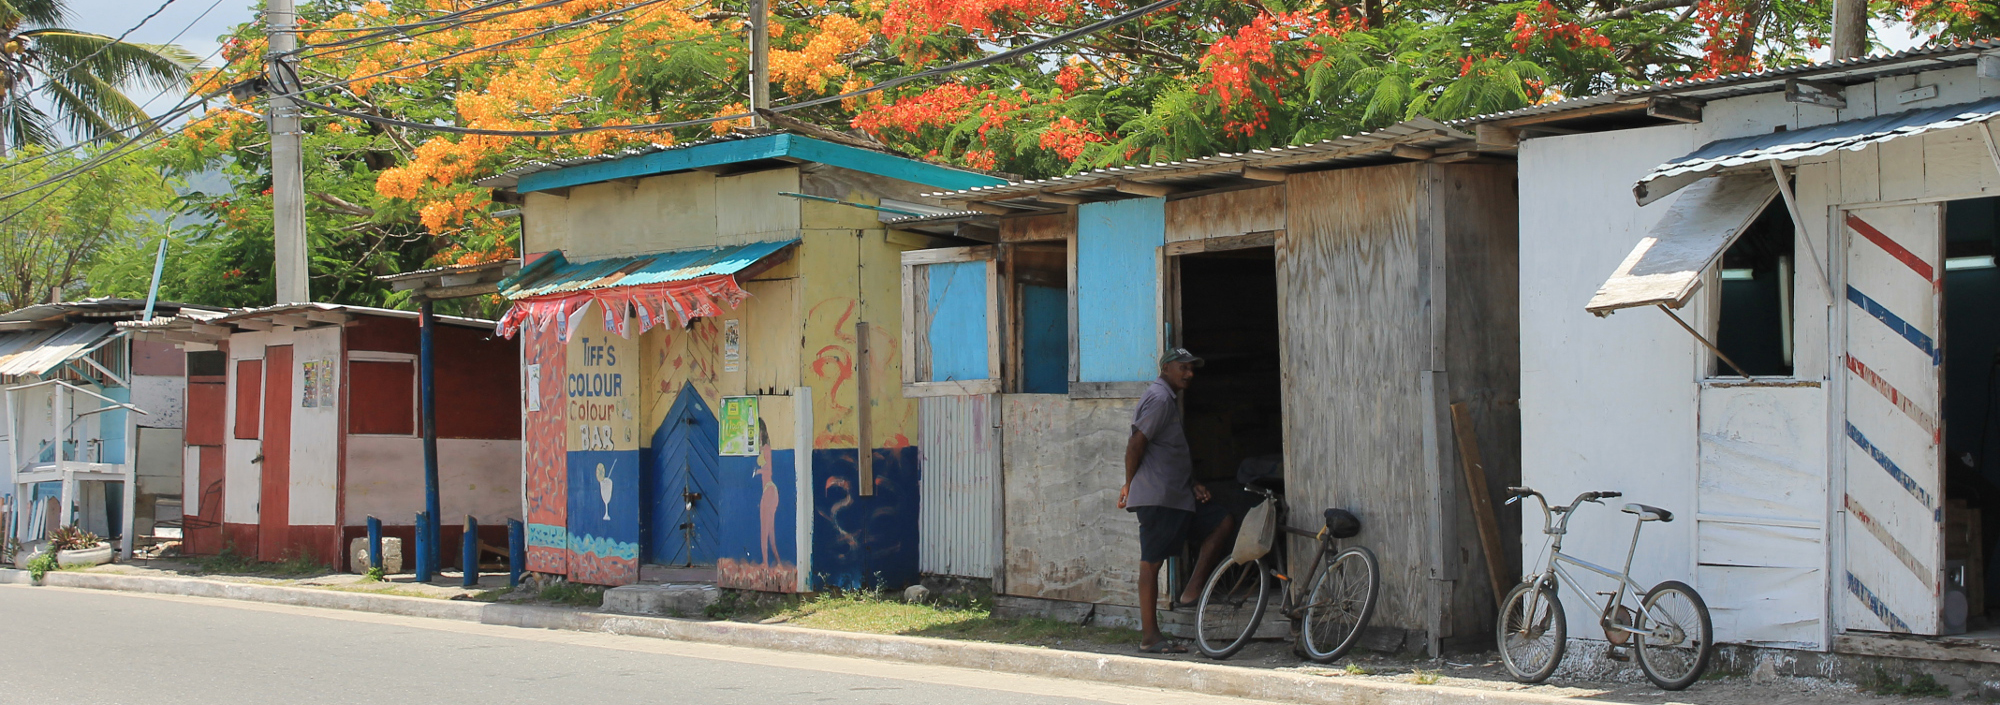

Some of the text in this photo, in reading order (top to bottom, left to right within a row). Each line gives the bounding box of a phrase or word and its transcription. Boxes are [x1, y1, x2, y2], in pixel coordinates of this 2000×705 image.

[582, 336, 616, 366] TIFF'S
[568, 373, 622, 397] COLOUR
[569, 400, 615, 421] Colour
[580, 424, 615, 451] BAR
